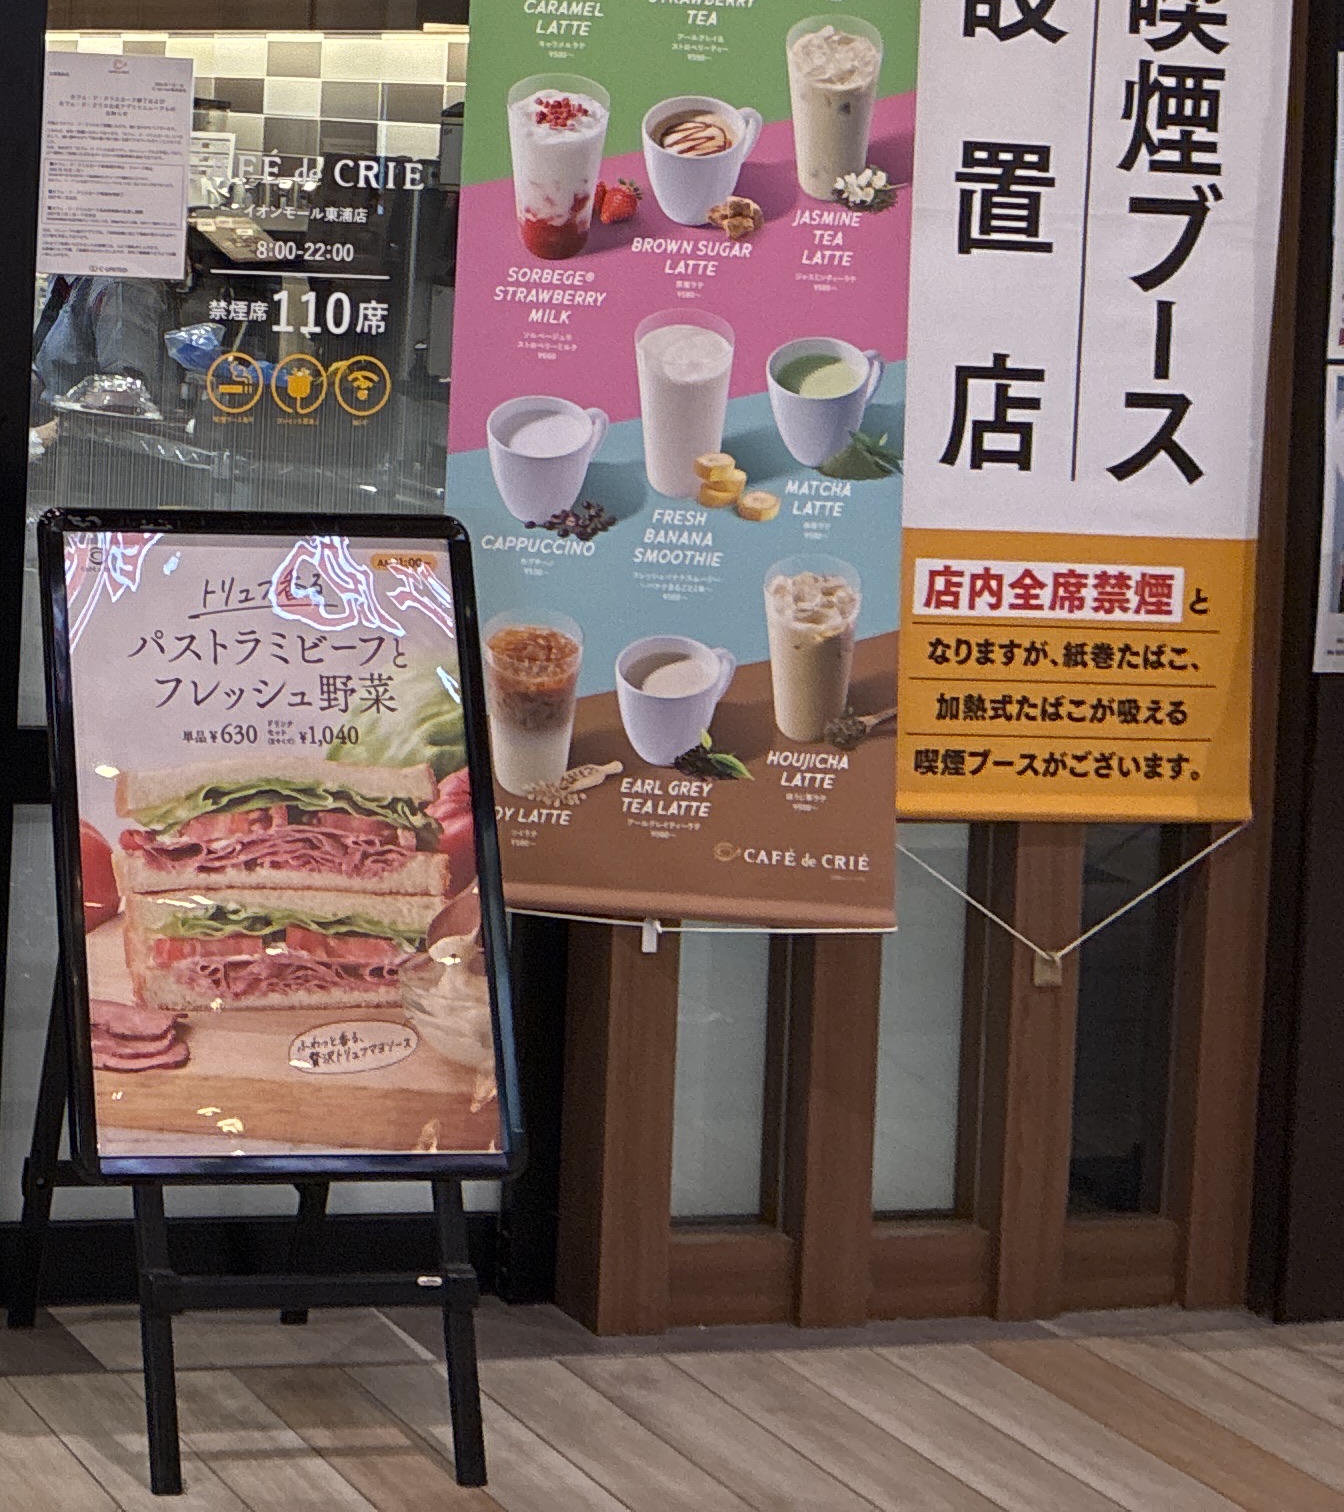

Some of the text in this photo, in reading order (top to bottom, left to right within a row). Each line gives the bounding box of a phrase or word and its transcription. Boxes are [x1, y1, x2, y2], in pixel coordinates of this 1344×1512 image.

[524, 0, 604, 17] CARAMEL
[687, 10, 718, 26] TEA
[536, 19, 592, 36] LATTE
[244, 204, 368, 224] イオンモール東浦店
[792, 209, 862, 227] JASMINE
[631, 237, 753, 258] BROWN SUGAR
[813, 230, 844, 246] TEA
[256, 240, 354, 262] 8:00-22:00
[801, 250, 854, 267] LATTE
[664, 259, 719, 277] LATTE
[494, 286, 607, 306] STRAWBERRY
[528, 308, 572, 324] MILK
[785, 480, 852, 498] MATCHA
[652, 509, 708, 527] FRESH
[792, 501, 845, 518] LATTE
[481, 535, 596, 557] CAPPUCCINO
[643, 528, 713, 548] BANANA
[632, 547, 724, 568] SMOOTHIE
[923, 564, 1210, 617] 店内全席禁煙 と
[127, 628, 409, 669] パストラミビーフと
[927, 638, 1199, 671] なりますが、紙巻たばこ、
[154, 672, 399, 714] フレッシュ野菜
[935, 692, 1188, 726] 加熱式たばこが吸える
[299, 724, 360, 746] ¥1,040
[766, 750, 850, 771] HOUJICHA
[913, 748, 1201, 781] 喫煙ブースがございます。
[620, 777, 713, 798] EARL GREY
[780, 771, 837, 789] LATTE
[517, 808, 573, 826] LATTE
[621, 797, 712, 818] TEA LATTE
[744, 846, 870, 871] CAFÉ de CRIÉ
